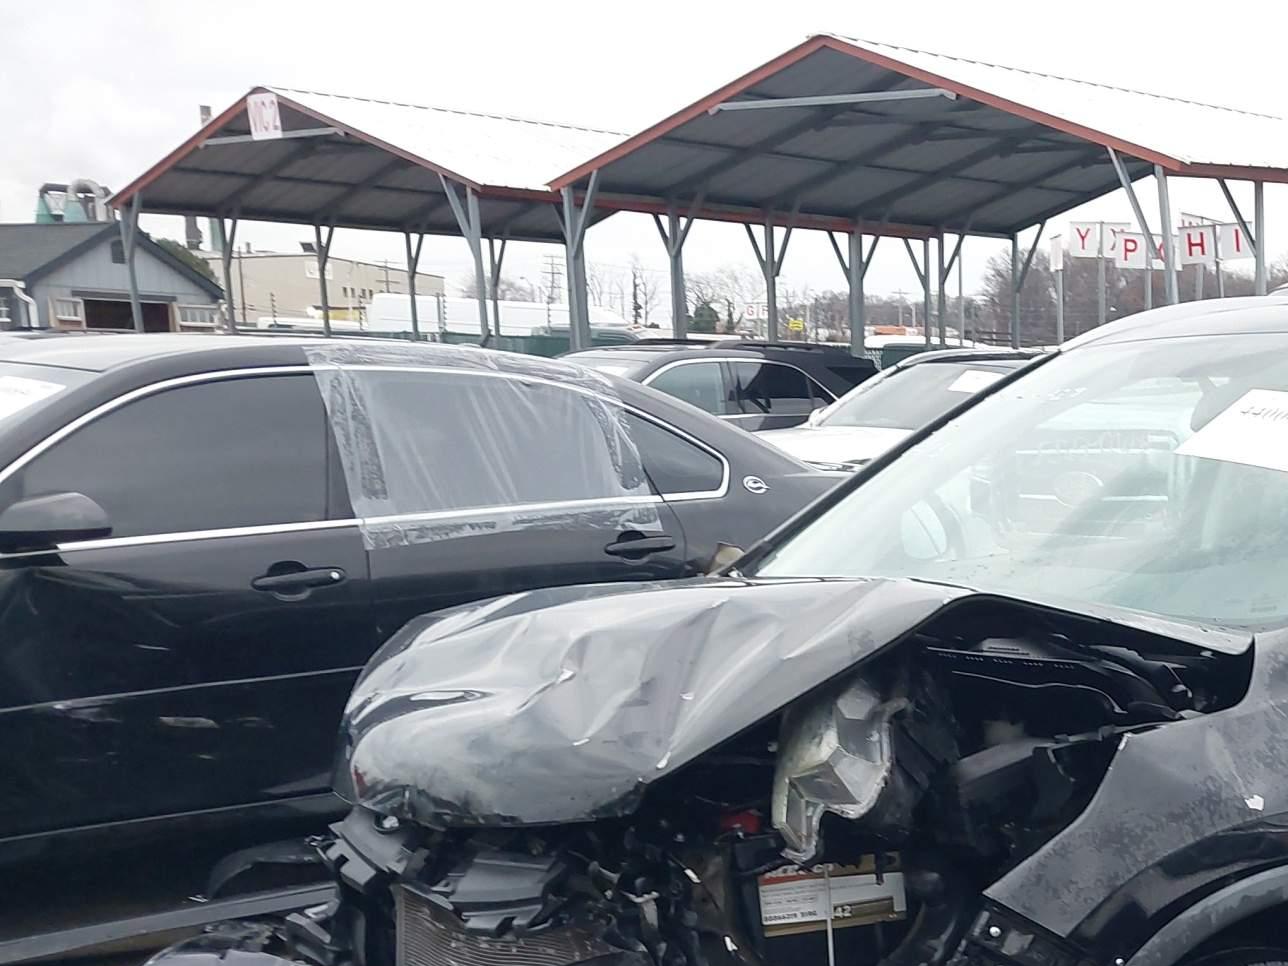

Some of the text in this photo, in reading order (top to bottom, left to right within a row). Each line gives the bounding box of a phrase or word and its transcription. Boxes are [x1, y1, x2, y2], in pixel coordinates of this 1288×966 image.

[1075, 226, 1091, 251] Y
[1123, 238, 1139, 262] P
[1186, 231, 1207, 257] H
